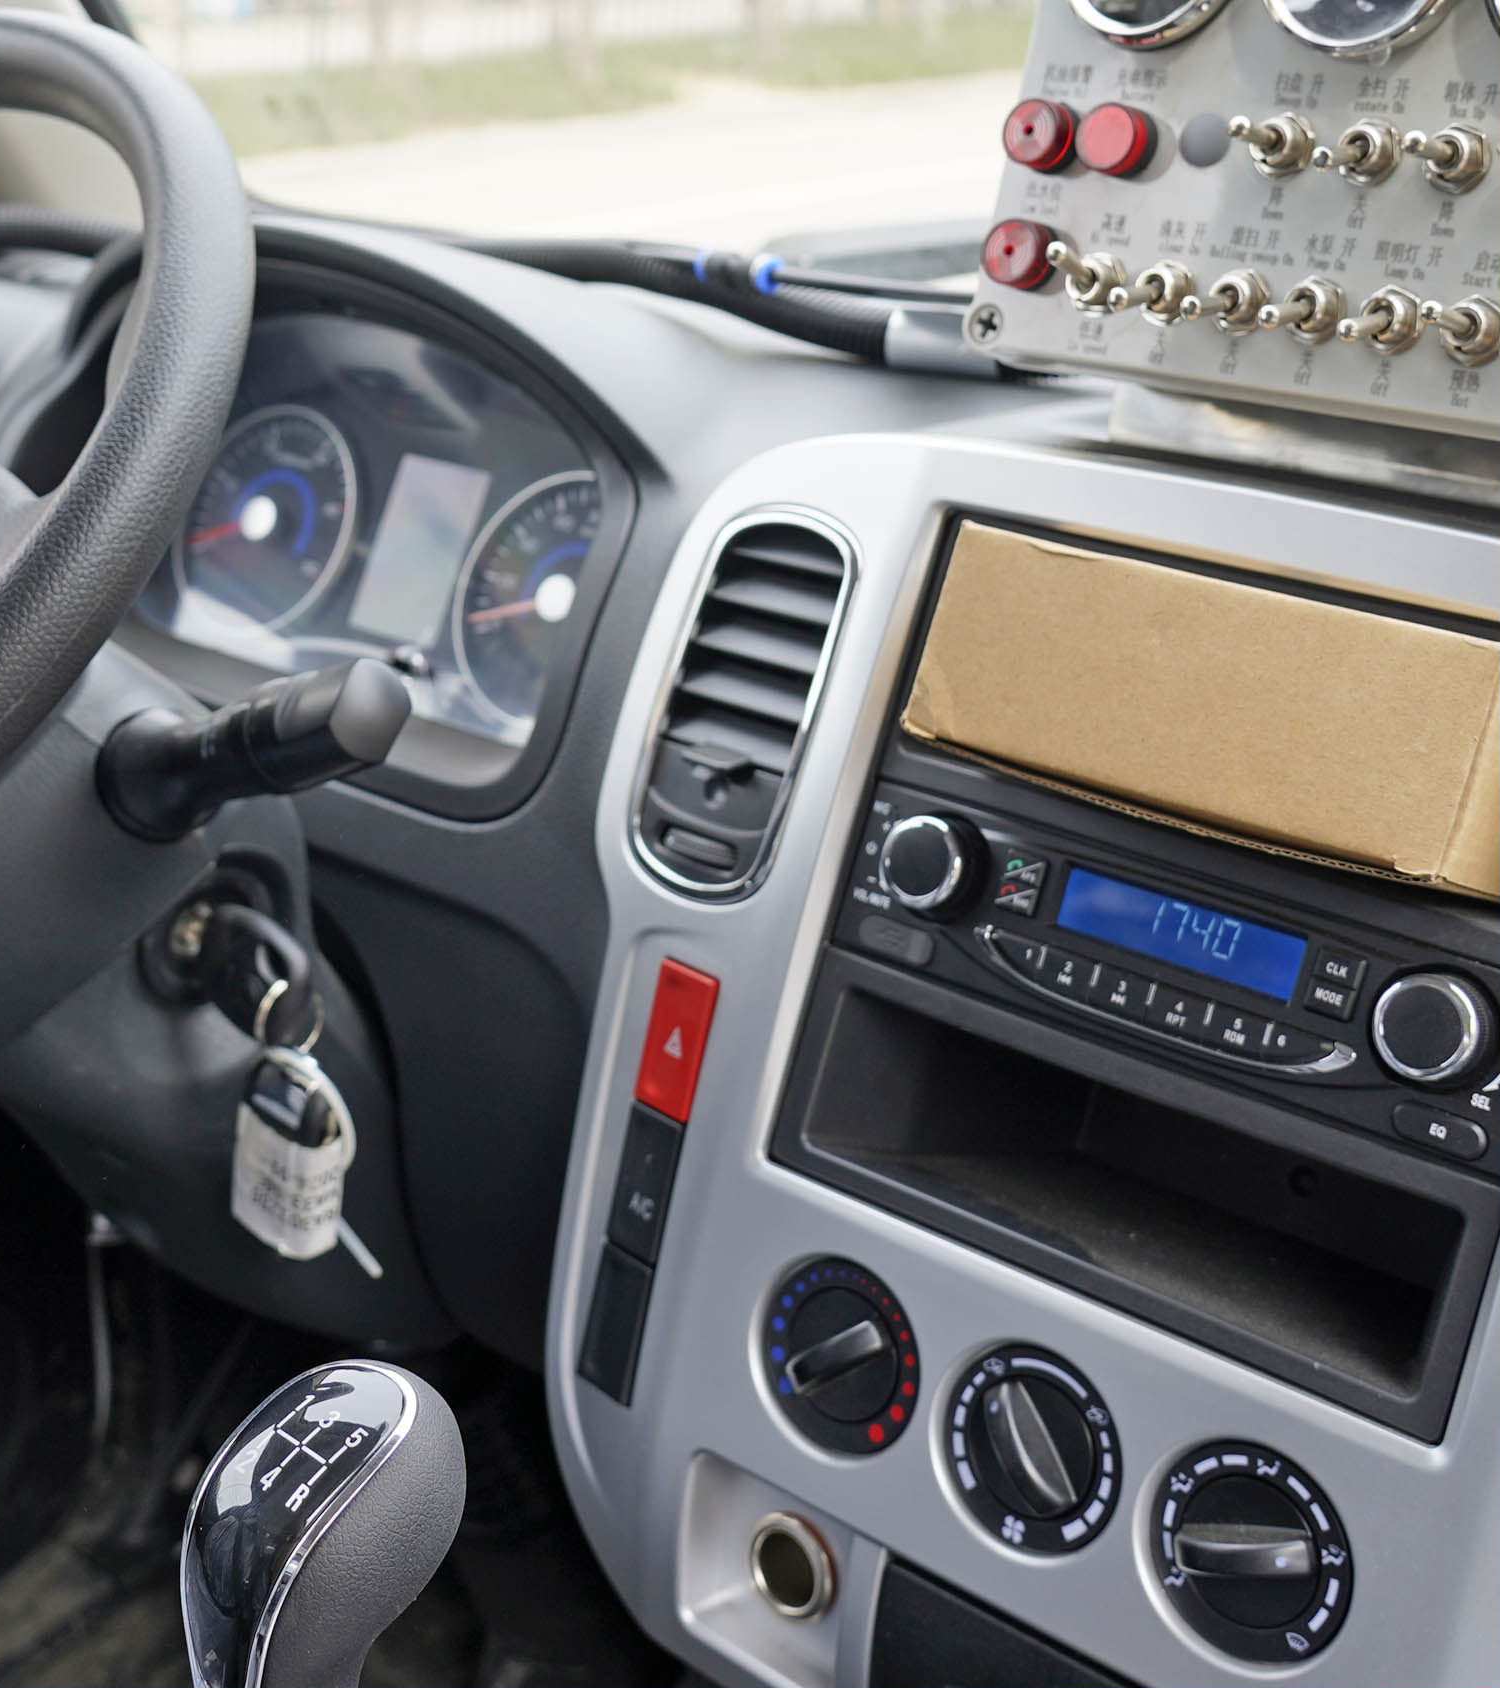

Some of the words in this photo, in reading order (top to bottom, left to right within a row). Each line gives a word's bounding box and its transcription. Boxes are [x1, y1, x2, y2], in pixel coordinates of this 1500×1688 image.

[1064, 961, 1072, 973] 2
[1326, 962, 1347, 977] CLK
[1118, 980, 1127, 993] 3
[1315, 987, 1343, 1005] MODE
[1175, 1001, 1183, 1012] 4
[1165, 1012, 1186, 1027] RPT
[1234, 1018, 1242, 1029] 5
[1278, 1034, 1286, 1047] 6
[1471, 1093, 1491, 1112] SEL
[1429, 1123, 1447, 1140] EQ
[345, 1427, 369, 1448] 5
[260, 1466, 282, 1491] 4
[285, 1483, 310, 1512] R
